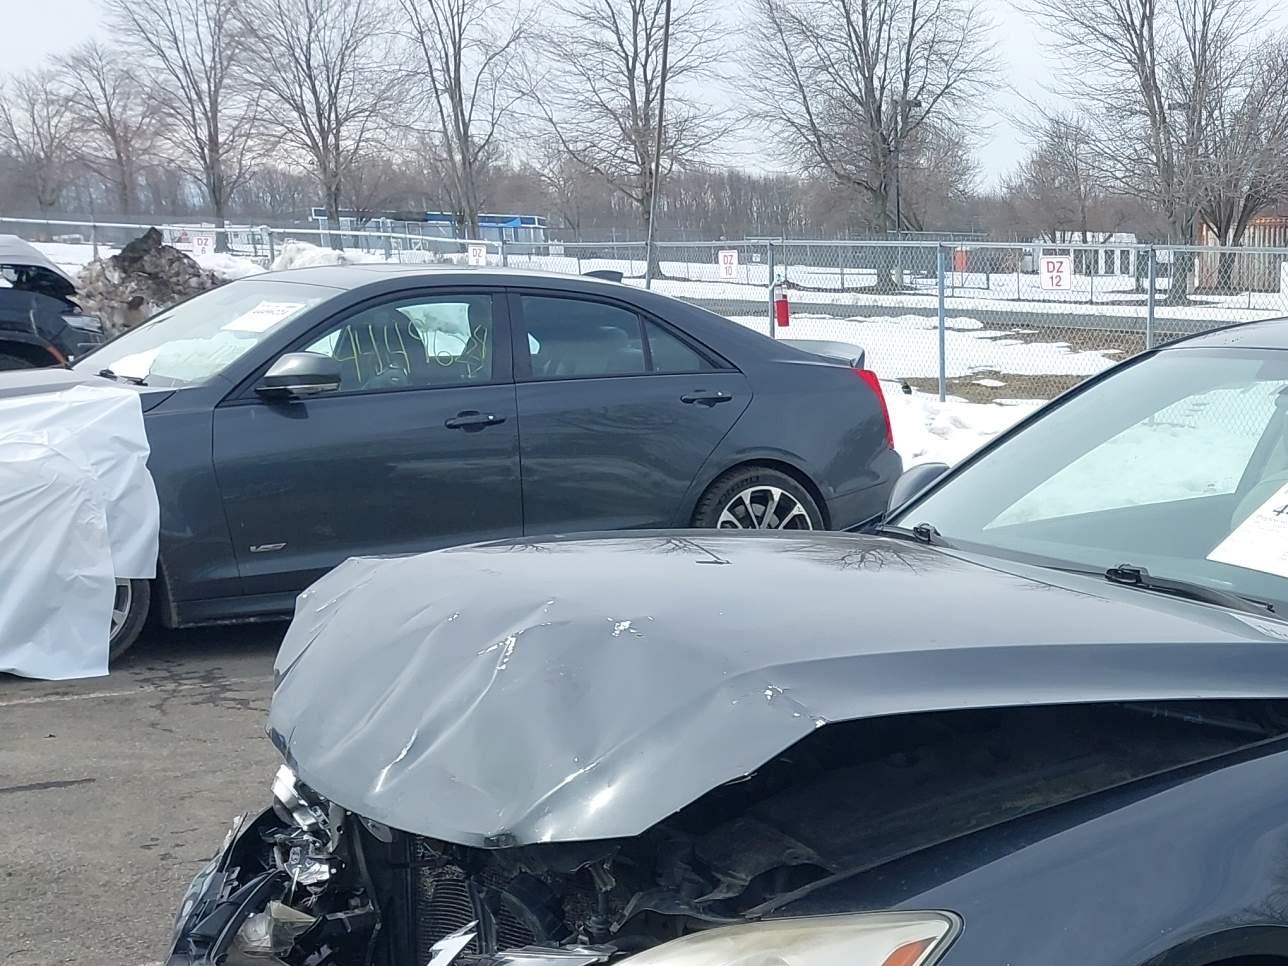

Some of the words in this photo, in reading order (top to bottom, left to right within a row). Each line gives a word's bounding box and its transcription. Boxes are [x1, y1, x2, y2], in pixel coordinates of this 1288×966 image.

[197, 237, 208, 246] DZ
[473, 248, 482, 257] DZ
[723, 254, 733, 265] DZ
[725, 266, 733, 276] 10
[1046, 261, 1064, 273] DZ
[1049, 275, 1062, 287] 12
